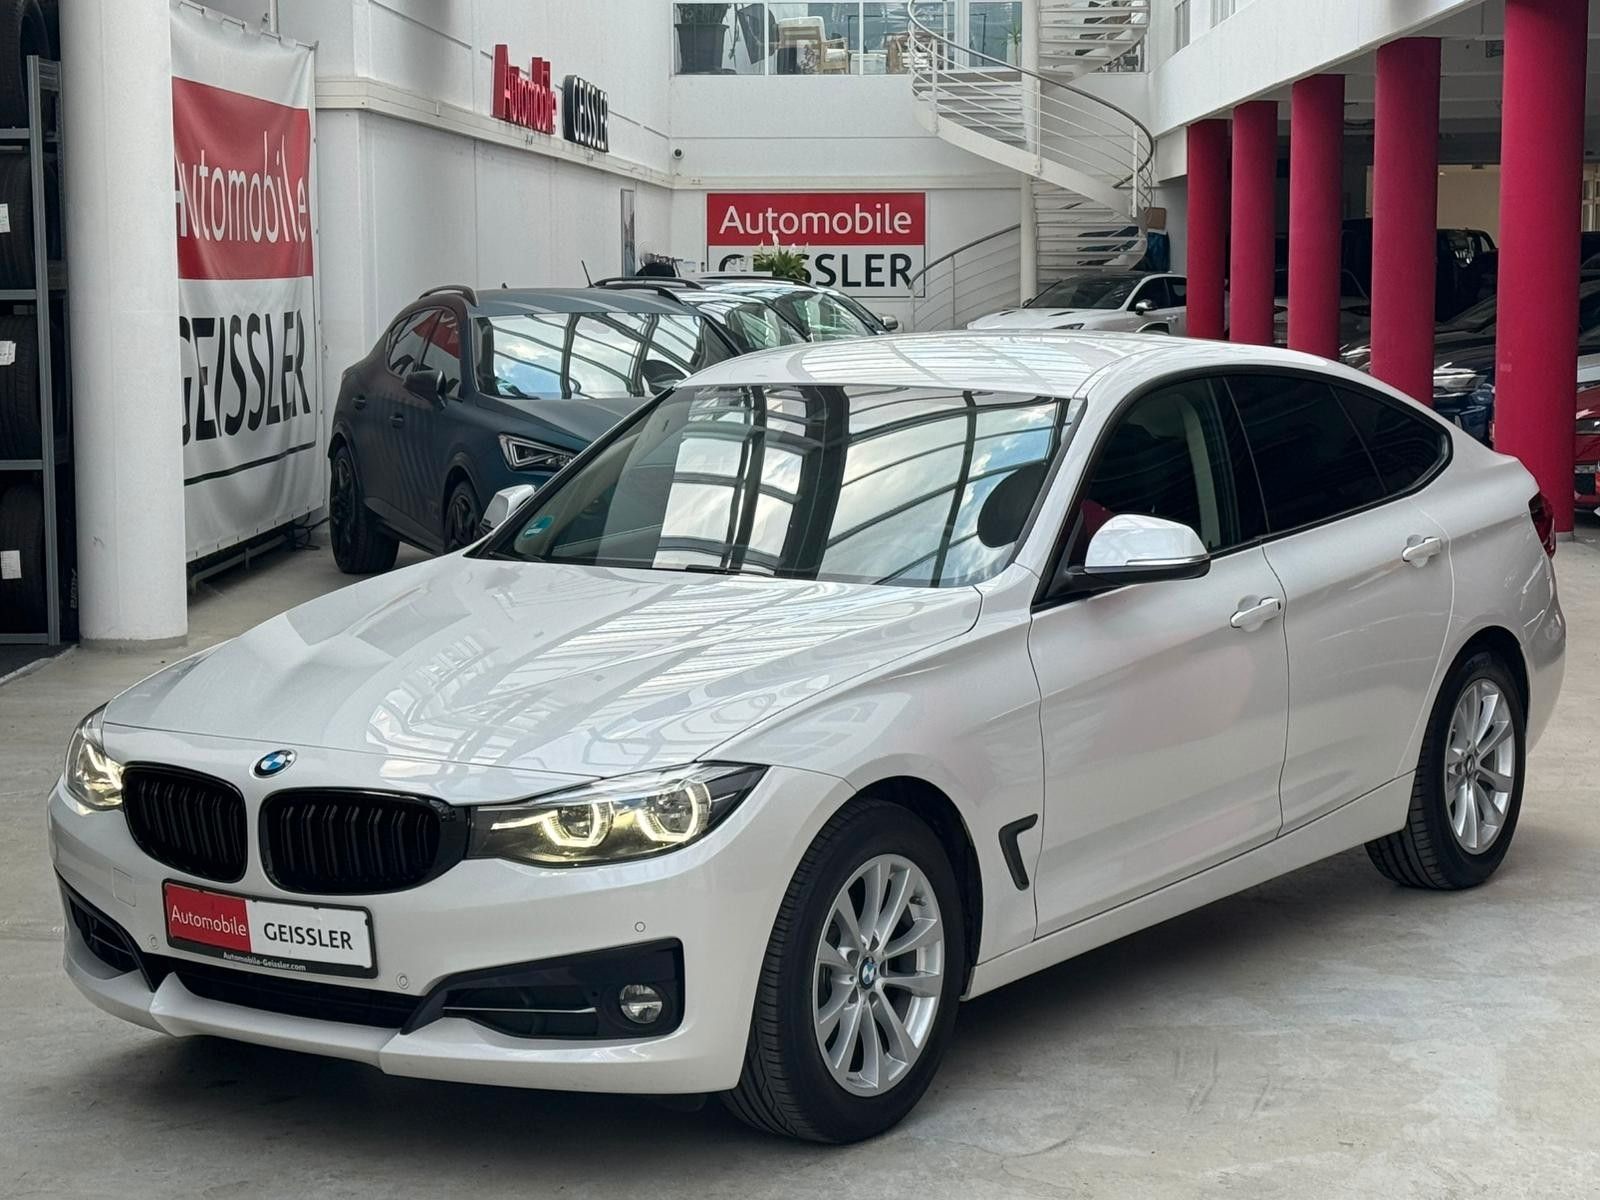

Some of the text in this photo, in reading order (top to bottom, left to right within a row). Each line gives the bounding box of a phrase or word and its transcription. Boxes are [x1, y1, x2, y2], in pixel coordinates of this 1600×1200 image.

[497, 51, 609, 152] Automobile GEISSLER
[719, 202, 912, 235] Automobile
[718, 253, 912, 288] SSLER
[171, 904, 353, 951] Automobile GEISSLER
[222, 951, 307, 972] Automobile-Geissler.com
